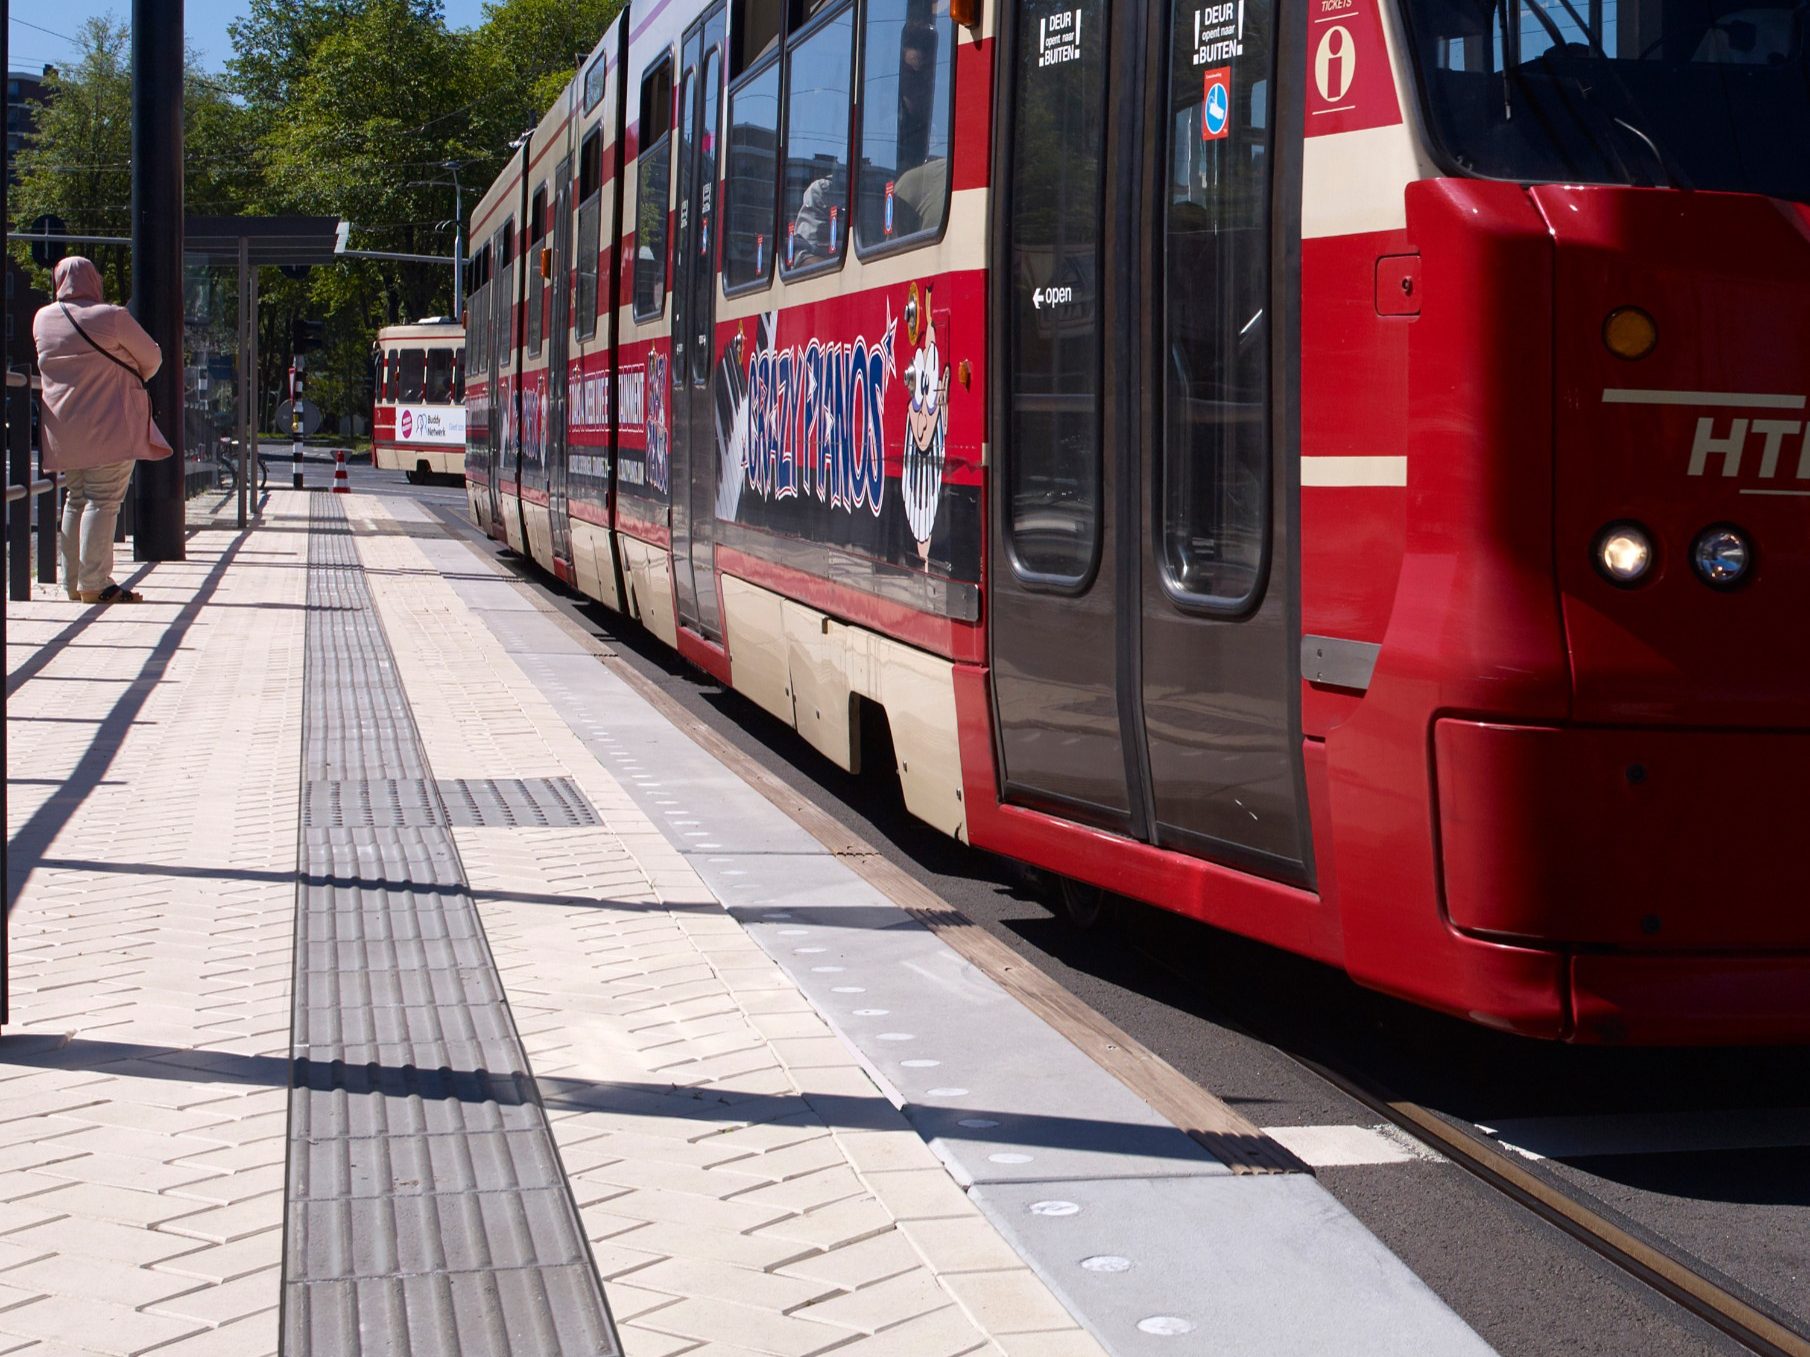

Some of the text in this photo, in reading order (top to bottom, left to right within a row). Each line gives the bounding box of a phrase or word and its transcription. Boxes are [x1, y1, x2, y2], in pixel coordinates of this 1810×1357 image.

[1204, 2, 1234, 26] DEUR
[1321, 0, 1352, 12] TICKETS
[1049, 11, 1072, 31] DEUR
[1045, 31, 1075, 49] opent naar
[1202, 24, 1236, 42] opent naar
[1044, 44, 1074, 66] BUITEN
[1199, 39, 1237, 64] BUITEN
[1045, 286, 1072, 312] open
[428, 414, 441, 426] Buddy
[746, 344, 805, 503] CRAZY
[803, 334, 886, 518] PIANOS
[1687, 417, 1810, 479] HT
